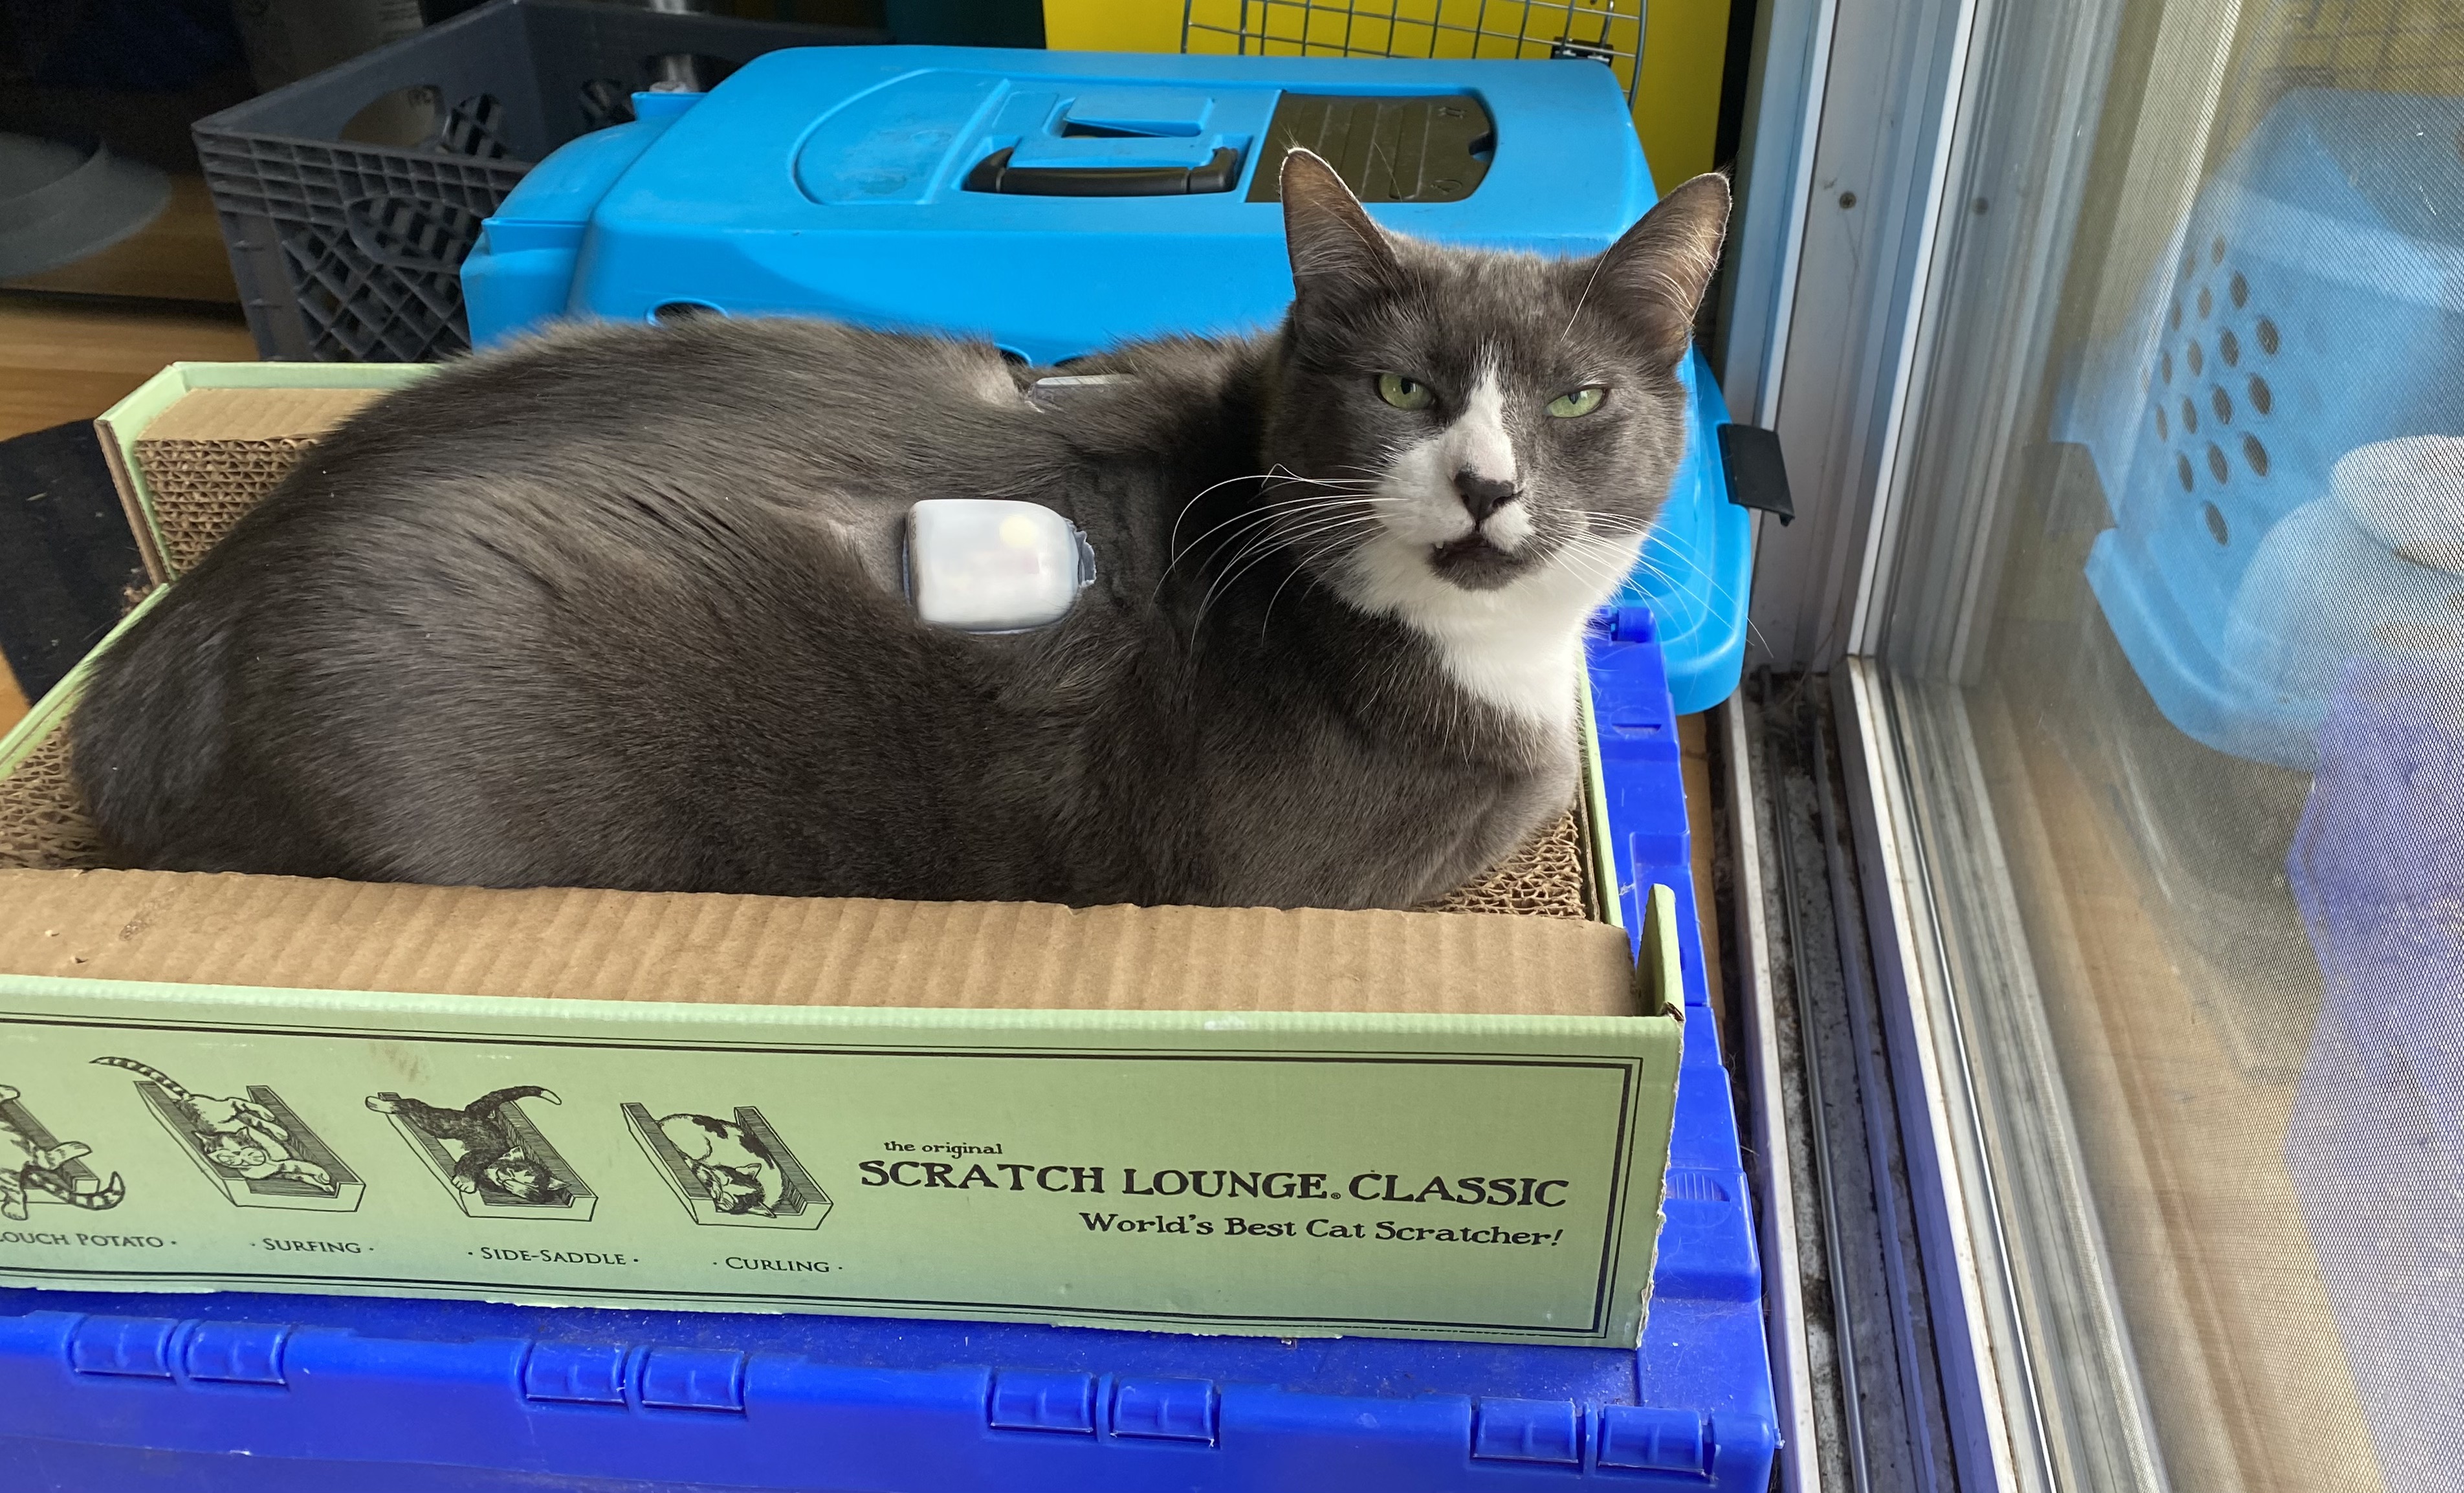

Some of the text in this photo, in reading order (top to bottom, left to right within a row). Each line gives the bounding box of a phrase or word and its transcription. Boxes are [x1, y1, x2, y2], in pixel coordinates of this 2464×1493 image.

[883, 1140, 1003, 1159] the original
[858, 1161, 1105, 1193] SCRATCH
[1348, 1173, 1570, 1208] CLASSIC
[1078, 1212, 1564, 1247] World's Best Cat Scratcher!
[76, 1233, 164, 1248] POTATO
[262, 1237, 362, 1254] SURFING
[480, 1247, 627, 1265] SIDE-SADDLE
[725, 1256, 830, 1273] CURLING
